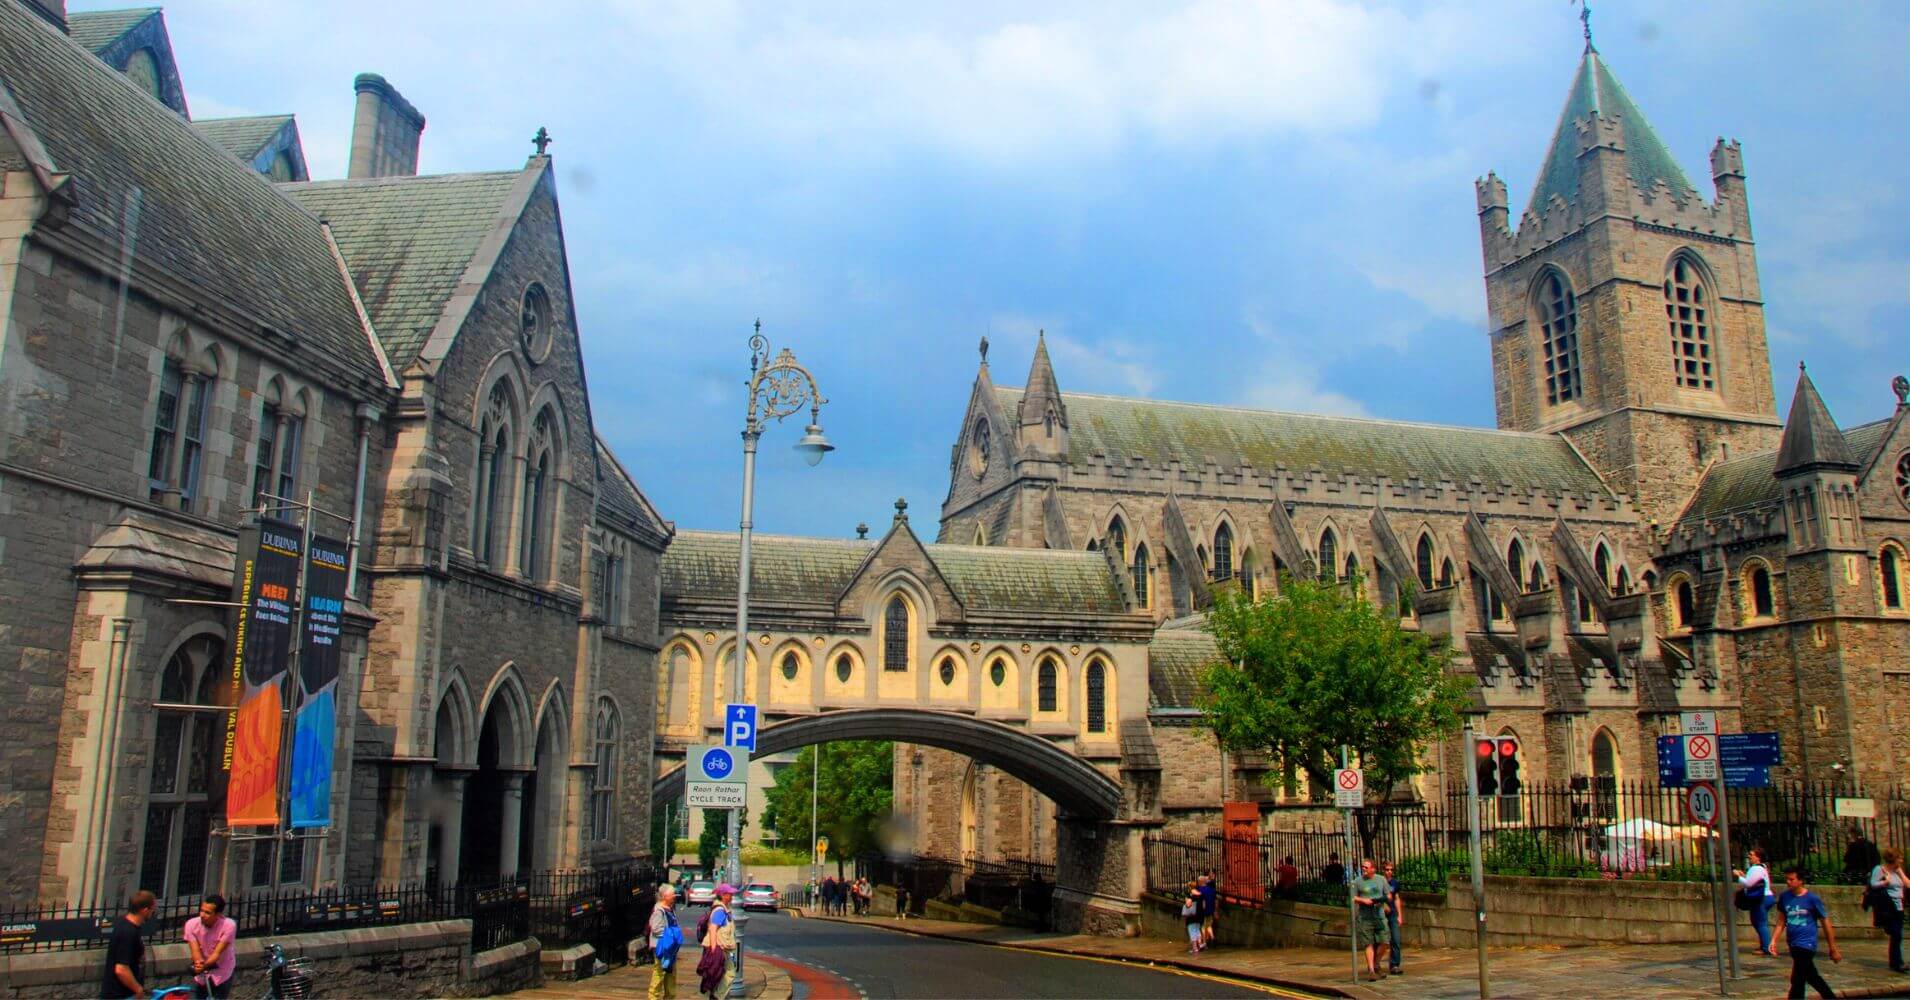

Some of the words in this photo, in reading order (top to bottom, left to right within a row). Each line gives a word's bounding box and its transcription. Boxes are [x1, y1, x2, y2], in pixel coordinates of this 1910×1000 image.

[263, 532, 298, 552] DUBLINIA
[312, 548, 345, 566] DUBLINIA
[261, 583, 289, 601] MEET
[310, 597, 342, 614] LEARN
[236, 621, 246, 654] VIKING
[233, 657, 242, 678] AND
[227, 681, 240, 730] MVAL
[731, 722, 751, 747] P
[222, 732, 235, 770] DUBLIN
[690, 795, 714, 803] CYCLE
[1695, 792, 1711, 812] 30
